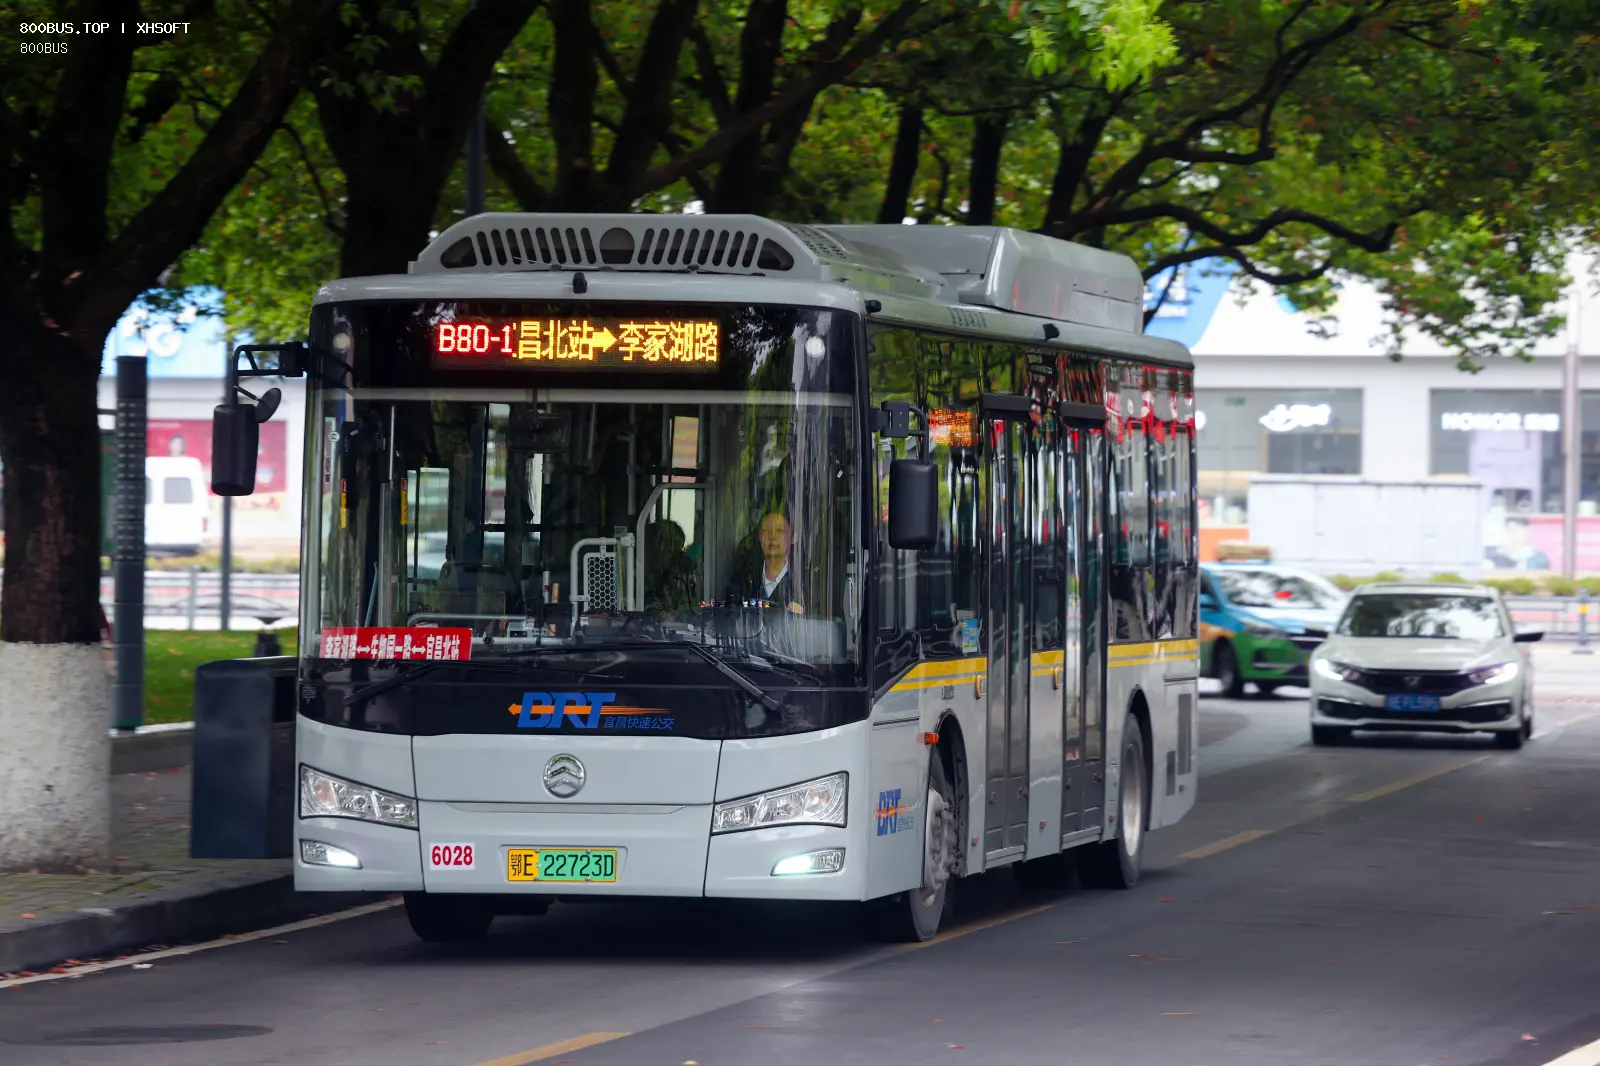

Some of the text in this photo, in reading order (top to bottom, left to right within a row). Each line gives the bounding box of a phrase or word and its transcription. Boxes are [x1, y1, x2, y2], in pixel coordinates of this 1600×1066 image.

[439, 319, 718, 362] B80-1 昌北站 李家湖路
[517, 691, 616, 729] BRT
[602, 716, 675, 730] 宜昌快速公交
[876, 787, 902, 837] BRT
[431, 845, 473, 866] 6028
[543, 853, 614, 877] 22723D
